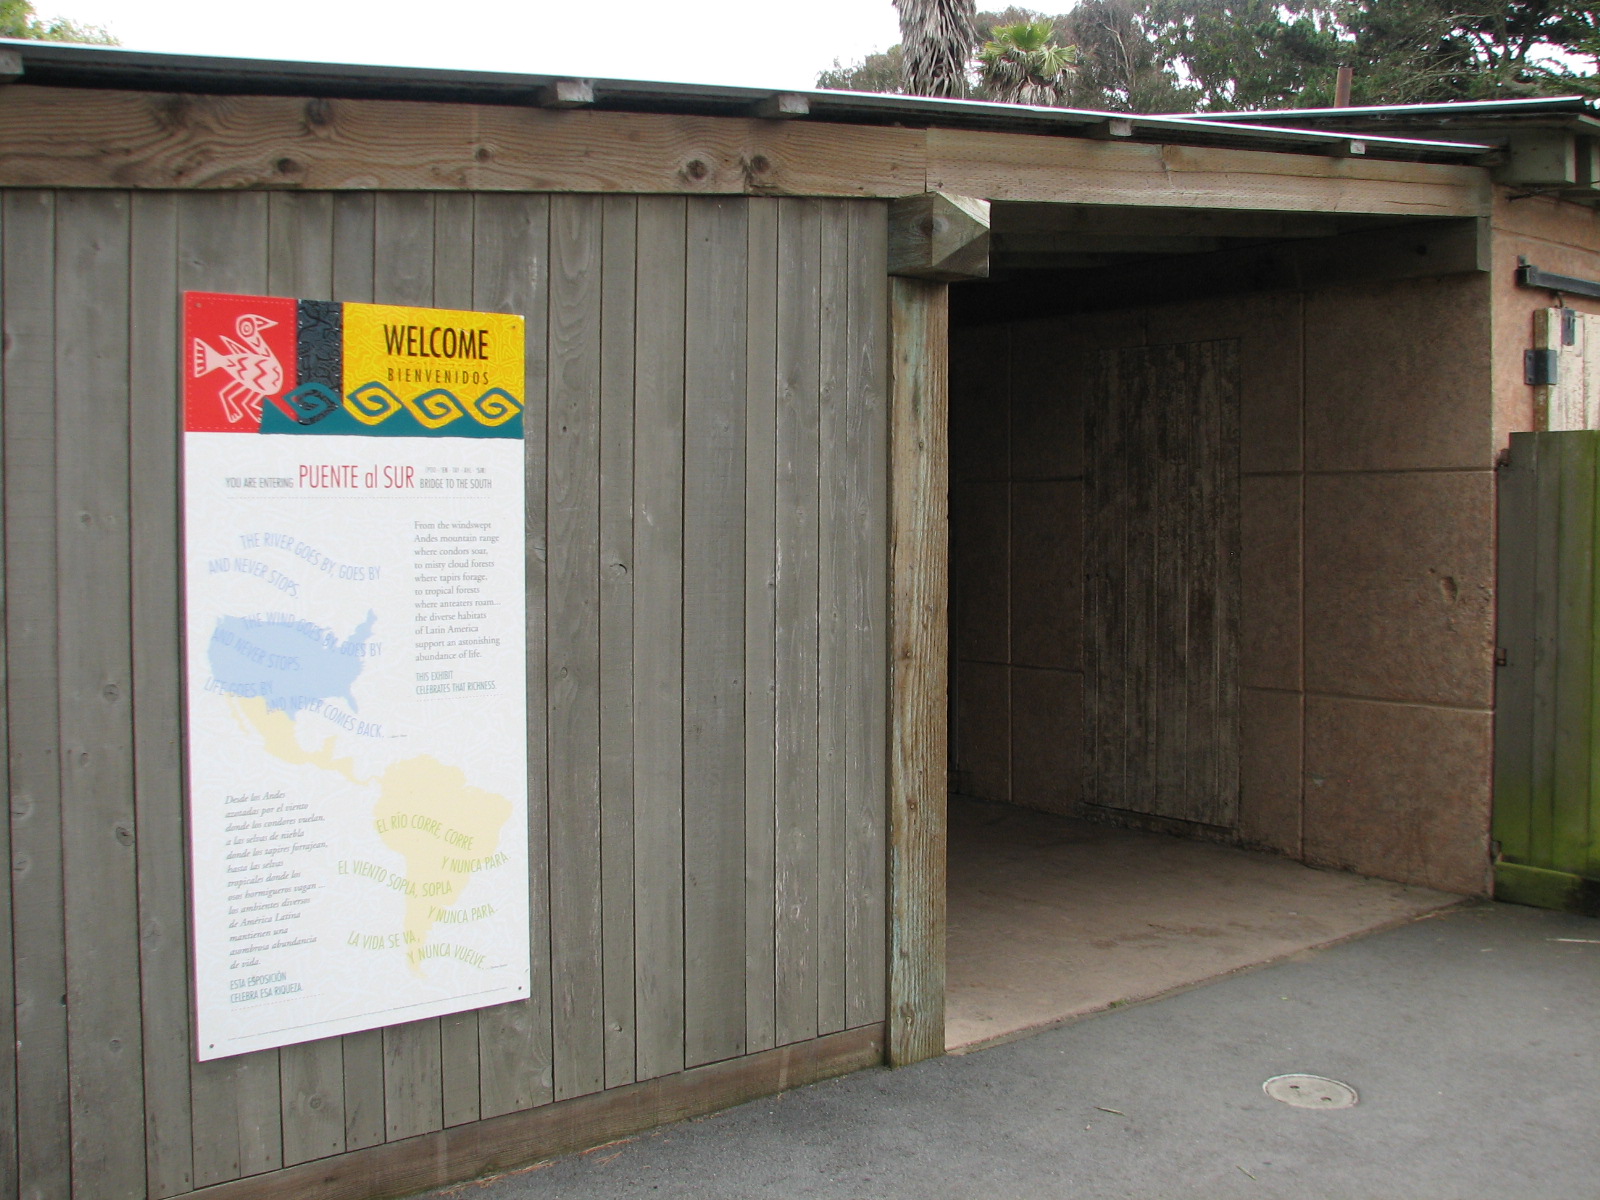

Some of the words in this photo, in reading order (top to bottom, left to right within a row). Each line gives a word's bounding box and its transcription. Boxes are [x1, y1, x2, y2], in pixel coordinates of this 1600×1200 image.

[384, 324, 489, 360] WELCOME
[388, 368, 489, 385] BIENVENIDOS
[225, 477, 241, 488] YOU
[243, 477, 257, 488] ARE
[260, 477, 294, 488] ENTERING
[299, 464, 358, 488] PUENTE
[365, 464, 378, 488] al
[384, 465, 415, 488] SUR
[420, 478, 444, 489] BRIDGE
[446, 478, 454, 489] TO
[456, 478, 468, 489] THE
[470, 478, 492, 489] SOUTH
[414, 521, 436, 530] From
[437, 520, 450, 530] the
[452, 520, 492, 531] windswept
[414, 534, 438, 542] Andes
[440, 533, 478, 542] mountain
[479, 535, 500, 544] range
[240, 532, 261, 550] THE
[264, 532, 295, 552] RIVER
[294, 541, 322, 566] GOES
[338, 564, 366, 582] GOES
[368, 566, 381, 581] BY
[414, 547, 438, 556] where
[439, 546, 470, 556] condors
[208, 558, 231, 575] AND
[234, 557, 269, 578] NEVER
[414, 562, 423, 570] to
[424, 560, 446, 571] misty
[448, 560, 469, 568] cloud
[470, 558, 495, 568] forests
[414, 574, 438, 582] where
[440, 572, 460, 584] tapirs
[414, 588, 423, 596] to
[425, 586, 454, 597] tropical
[456, 584, 480, 594] forests
[414, 600, 438, 609] where
[440, 600, 473, 608] anteaters
[415, 613, 428, 622] the
[430, 612, 456, 622] diverse
[458, 611, 487, 620] habitats
[415, 626, 424, 635] of
[425, 626, 446, 635] Latin
[447, 624, 479, 634] America
[370, 642, 382, 658] BY
[415, 640, 444, 650] support
[458, 636, 500, 646] astonishing
[416, 652, 457, 662] abundance
[458, 650, 468, 658] of
[416, 672, 430, 682] THIS
[431, 670, 454, 681] EXHIBIT
[416, 684, 451, 695] CELEBRATES
[452, 682, 466, 692] THAT
[324, 704, 356, 732] COMES
[224, 794, 249, 804] Desde
[250, 792, 261, 802] los
[262, 790, 286, 800] Andes
[260, 806, 275, 818] por
[276, 804, 284, 812] el
[285, 802, 309, 812] viento
[225, 820, 250, 832] donde
[251, 820, 262, 830] los
[376, 818, 388, 834] EL
[391, 811, 408, 830] RÍO
[444, 828, 474, 851] CORRE
[234, 836, 244, 846] las
[246, 834, 268, 844] selvas
[270, 832, 279, 841] de
[281, 828, 304, 839] niebla
[226, 848, 251, 860] donde
[252, 848, 262, 857] los
[226, 864, 248, 874] hasta
[250, 862, 260, 871] las
[442, 856, 450, 870] Y
[450, 858, 482, 874] NUNCA
[227, 874, 264, 888] tropicales
[266, 870, 290, 882] donde
[291, 870, 302, 880] los
[338, 860, 349, 875] EL
[353, 860, 388, 883] VIENTO
[422, 880, 452, 898] SOPLA
[227, 893, 243, 902] osos
[244, 887, 292, 898] hormigueros
[228, 906, 239, 915] los
[240, 902, 280, 913] ambientes
[281, 897, 311, 907] diversos
[229, 919, 239, 928] de
[275, 912, 302, 922] Latina
[428, 906, 436, 919] Y
[436, 908, 469, 924] NUNCA
[229, 930, 272, 942] mantienen
[274, 928, 288, 936] una
[347, 930, 360, 948] LA
[363, 935, 385, 950] VIDA
[388, 933, 400, 949] SE
[229, 944, 270, 956] asombrosa
[271, 934, 318, 950] abundancia
[408, 952, 416, 964] Y
[418, 942, 451, 962] NUNCA
[230, 960, 240, 970] de
[230, 978, 246, 990] ESTA
[230, 989, 259, 1003] CELEBRA
[260, 988, 274, 998] ESA
